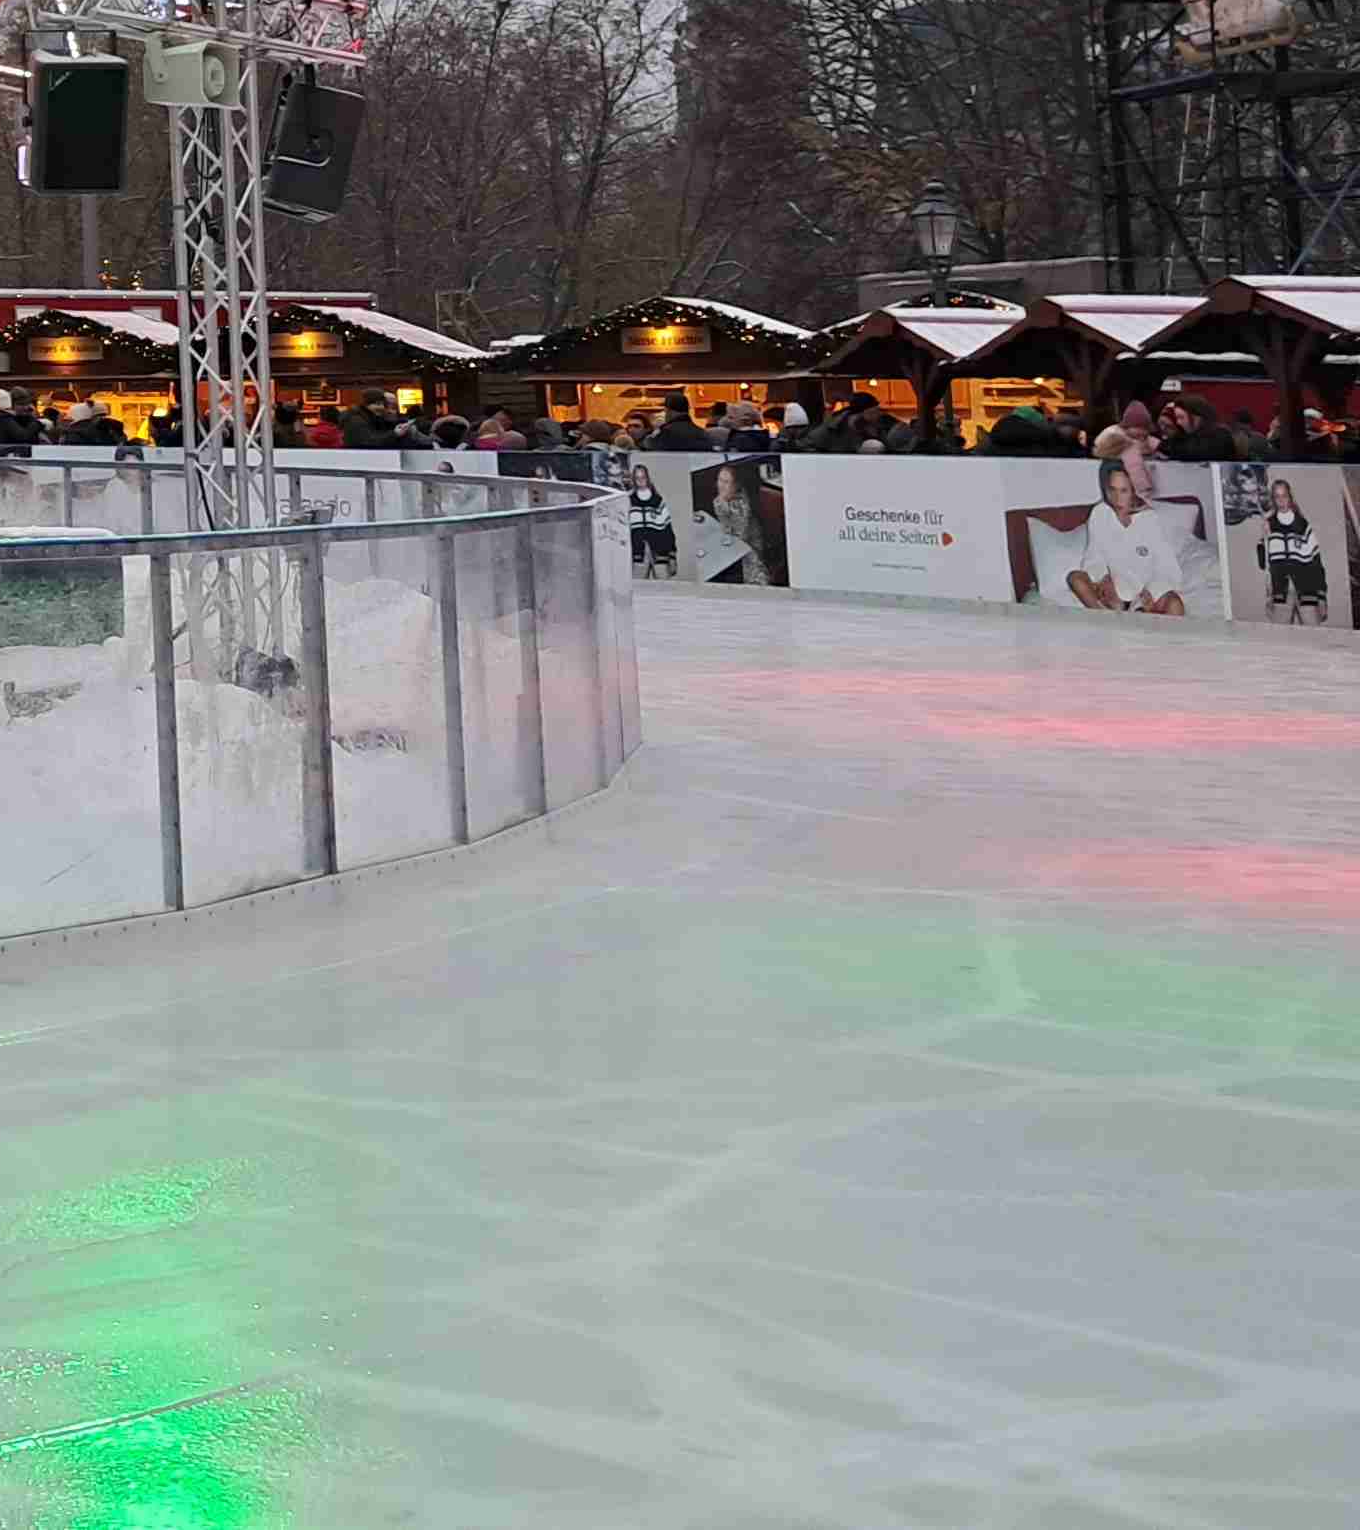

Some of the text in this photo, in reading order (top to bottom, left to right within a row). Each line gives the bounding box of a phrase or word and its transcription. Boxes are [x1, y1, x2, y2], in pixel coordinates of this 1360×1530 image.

[844, 505, 945, 526] Geschenke für
[838, 525, 940, 546] all deine Seiten
